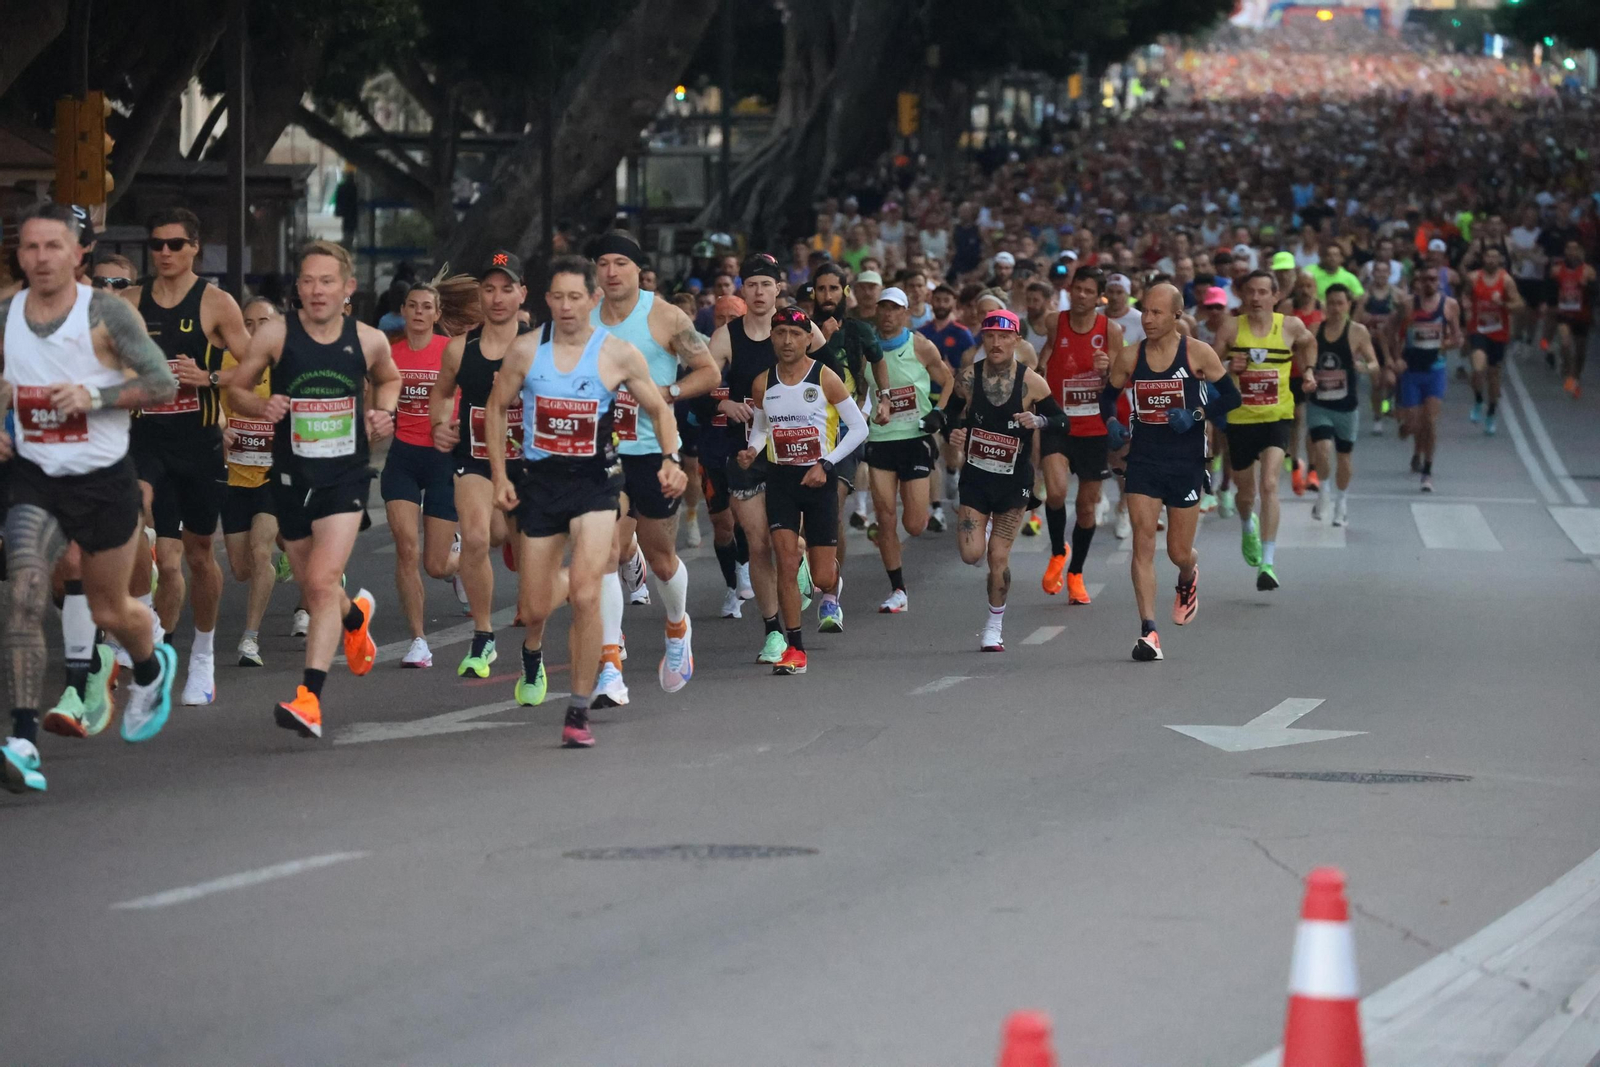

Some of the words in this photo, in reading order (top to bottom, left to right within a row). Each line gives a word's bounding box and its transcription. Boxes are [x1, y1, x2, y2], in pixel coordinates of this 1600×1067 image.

[404, 372, 438, 380] GENERALI
[404, 386, 428, 396] 1646
[1072, 392, 1097, 400] 11115
[1147, 395, 1172, 405] 6256
[309, 400, 351, 411] GENERALI
[548, 400, 594, 411] GENERALI
[240, 421, 274, 431] GENERALI
[548, 417, 579, 431] 3921
[783, 427, 816, 437] GENERALI
[237, 435, 266, 447] 15964
[983, 432, 1016, 446] GENERALI
[785, 442, 809, 452] 1054
[979, 444, 1007, 457] 10449
